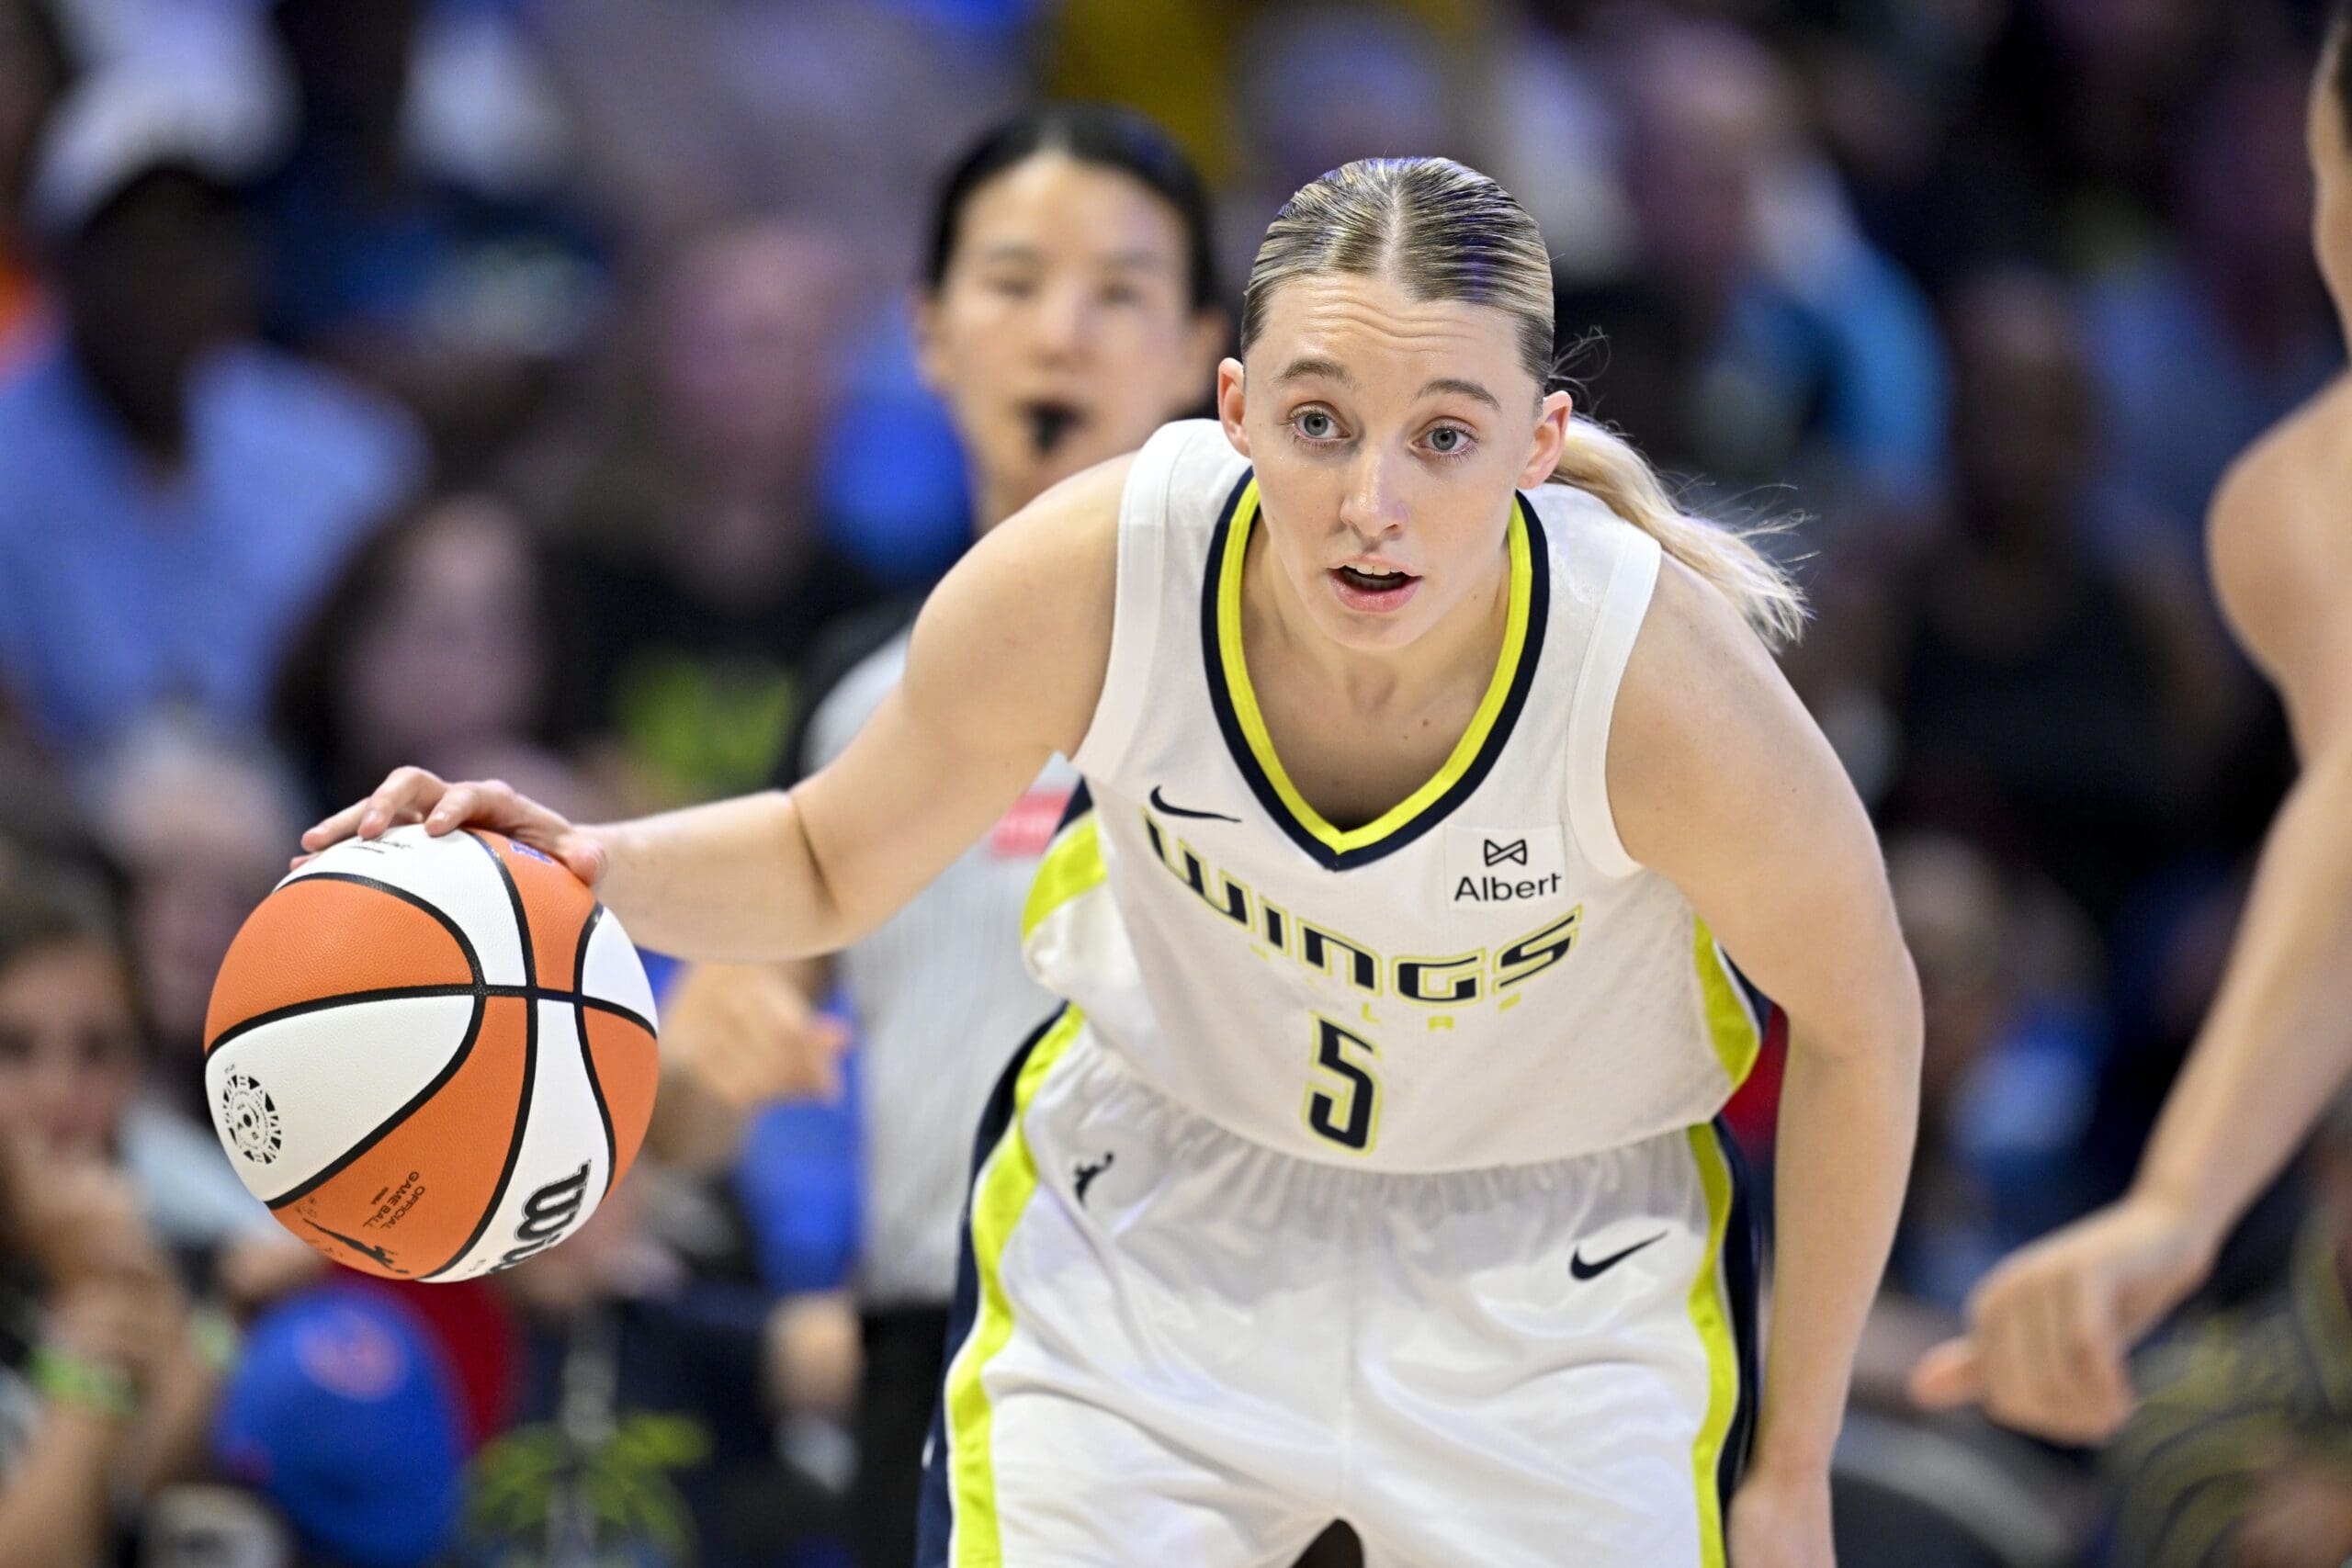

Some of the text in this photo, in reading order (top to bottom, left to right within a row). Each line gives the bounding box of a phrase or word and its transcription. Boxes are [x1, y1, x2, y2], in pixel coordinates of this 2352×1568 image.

[1454, 873, 1562, 901] Albert
[1141, 806, 1583, 1008] WINGS
[1301, 1010, 1382, 1156] 5
[388, 1170, 420, 1205] GAME
[362, 1204, 391, 1229] BALL
[379, 1186, 425, 1229] OFFICIAL
